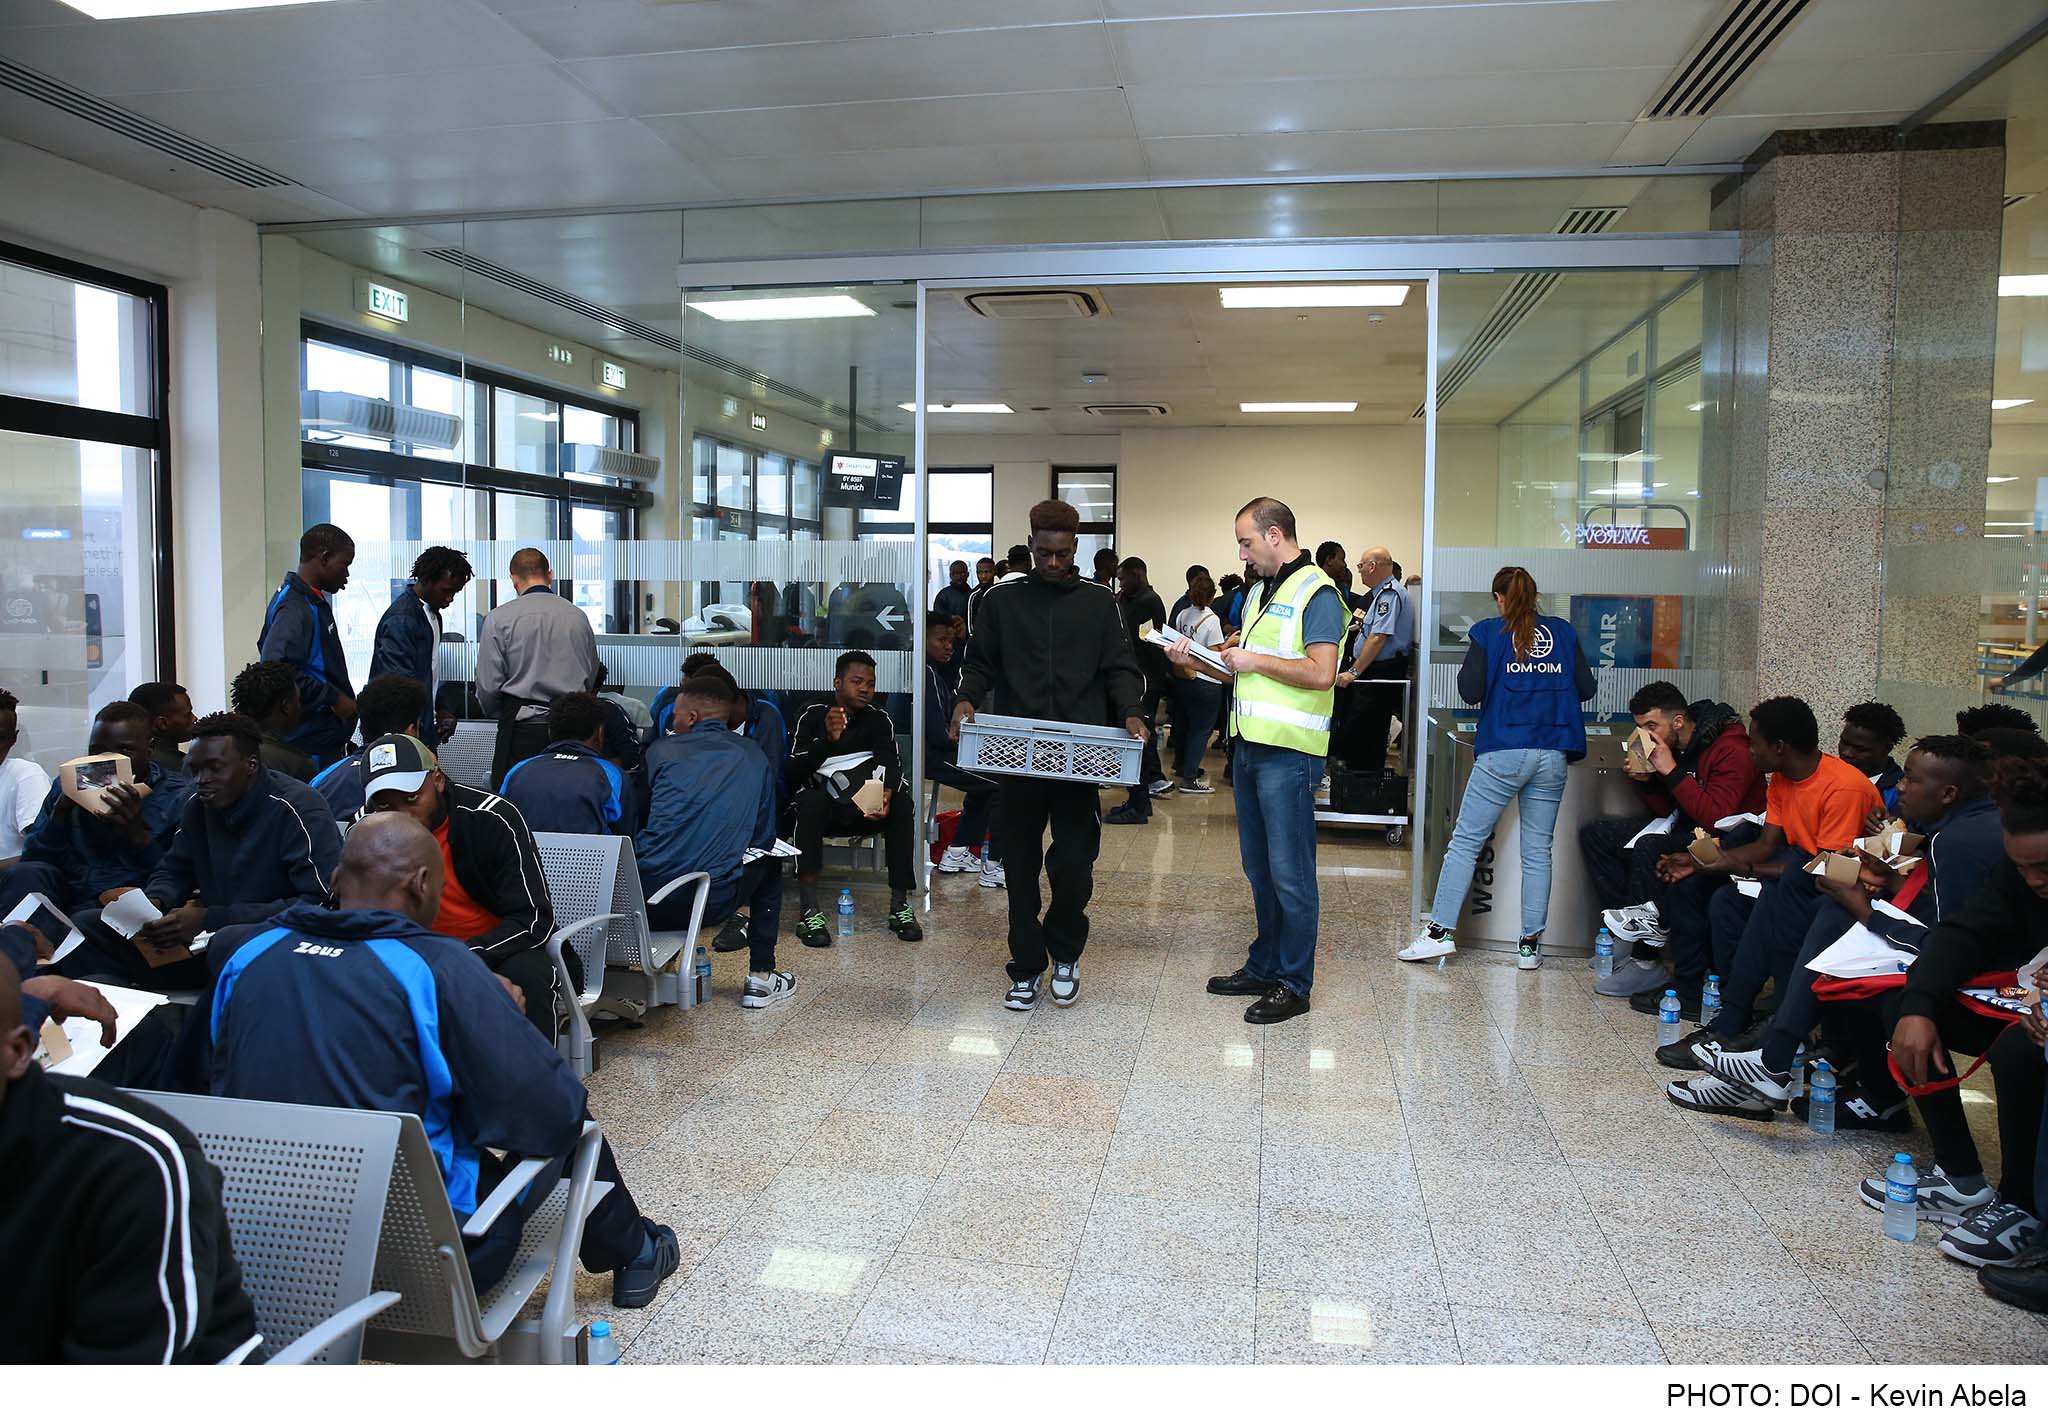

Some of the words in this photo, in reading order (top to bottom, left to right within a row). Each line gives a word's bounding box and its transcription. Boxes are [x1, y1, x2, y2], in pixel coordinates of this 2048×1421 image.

[373, 289, 404, 315] EXIT
[605, 366, 624, 385] EXIT
[840, 482, 865, 491] Munich
[1472, 831, 1495, 915] was
[293, 941, 344, 957] Zeus
